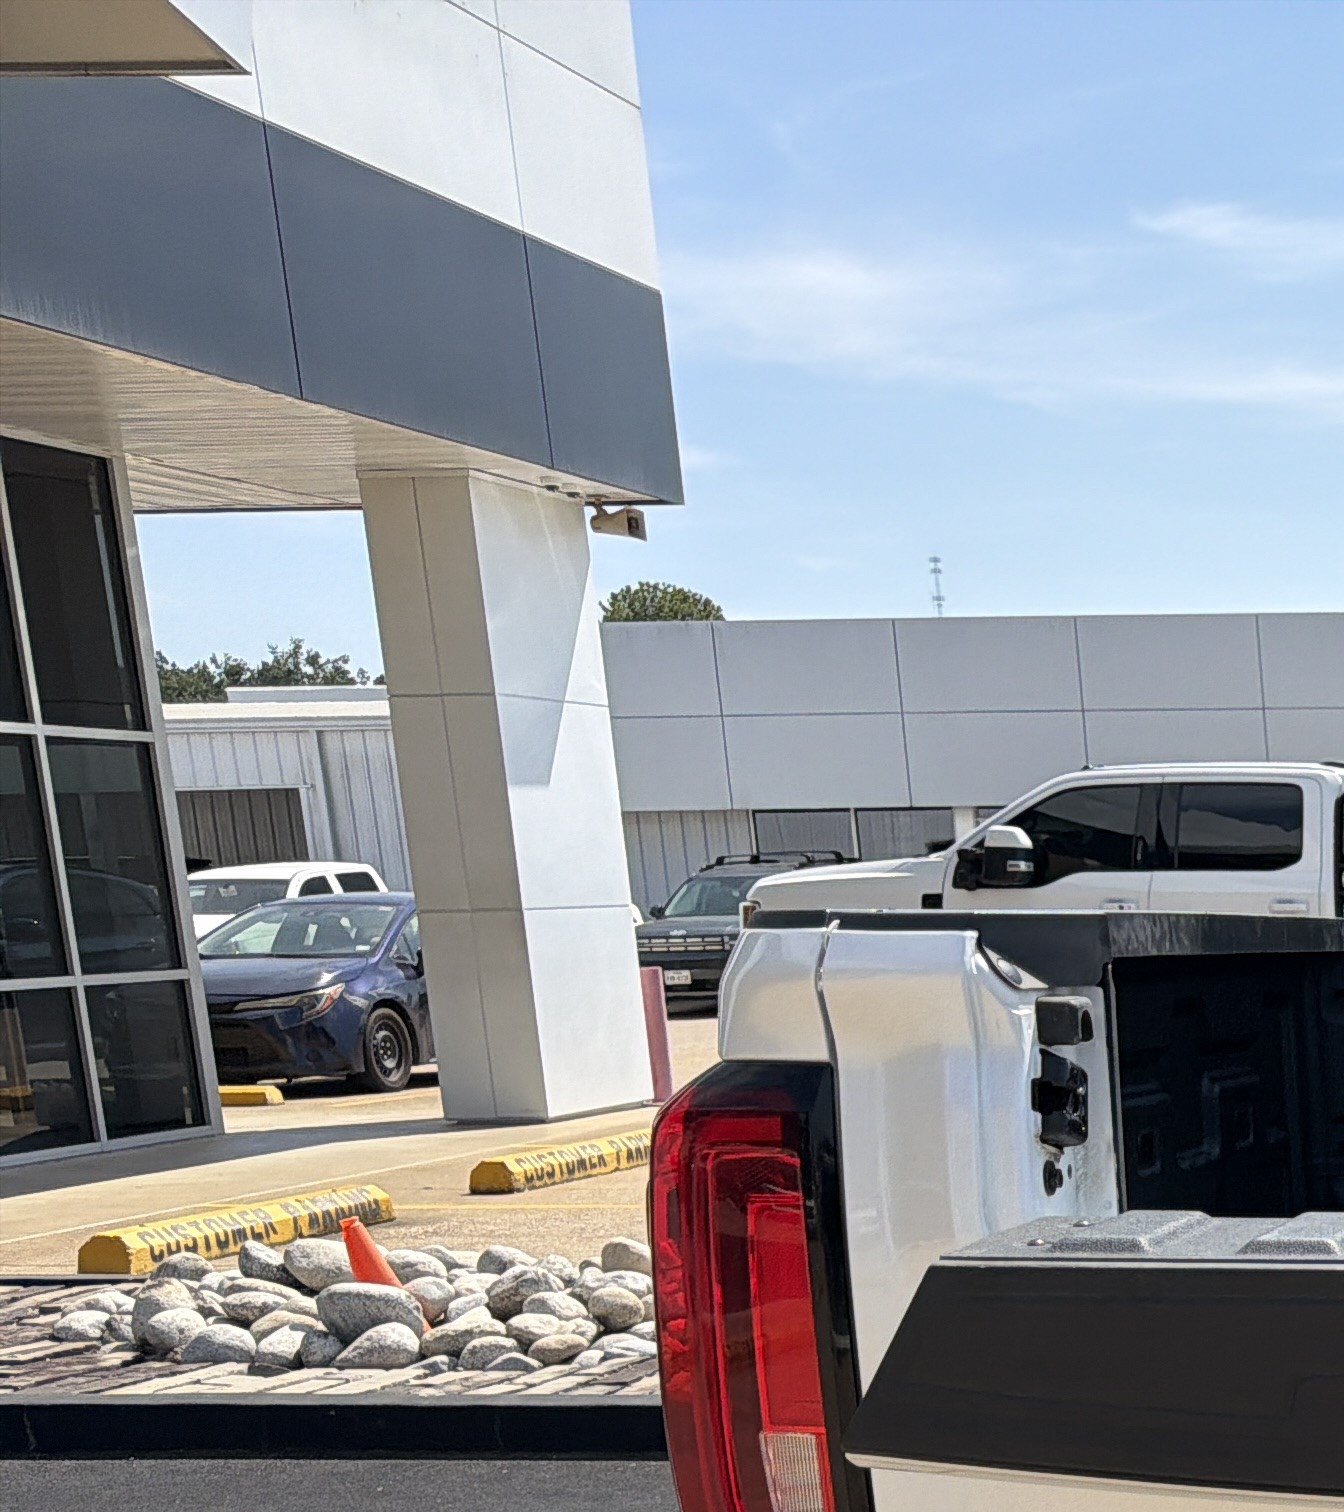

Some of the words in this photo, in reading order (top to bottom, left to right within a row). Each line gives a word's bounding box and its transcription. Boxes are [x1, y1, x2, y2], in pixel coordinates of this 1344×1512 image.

[514, 1143, 608, 1184] CUSTOMER
[136, 1206, 278, 1263] CUSTOMER
[280, 1187, 380, 1235] PARKING
